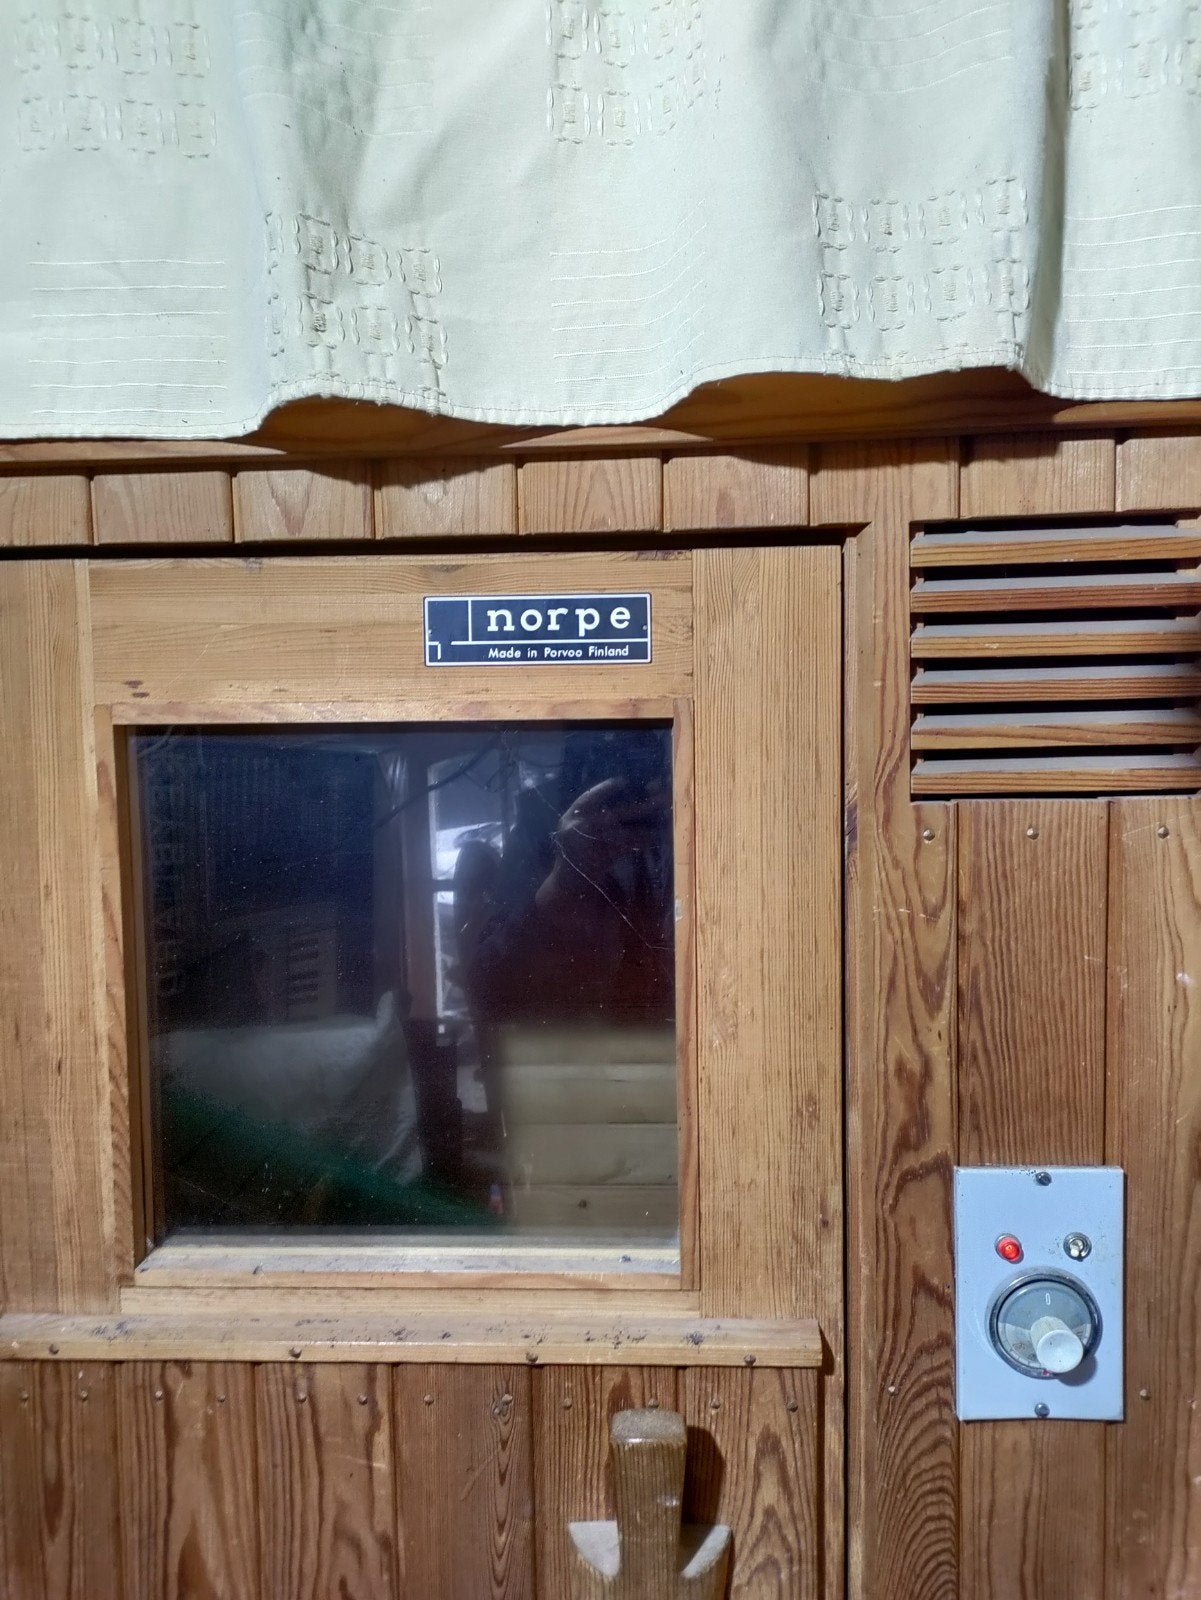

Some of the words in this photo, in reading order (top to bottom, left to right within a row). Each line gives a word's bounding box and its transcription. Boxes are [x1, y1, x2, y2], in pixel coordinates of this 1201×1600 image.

[487, 606, 631, 637] norpe
[488, 647, 521, 659] Made
[527, 648, 538, 658] in
[544, 646, 583, 658] Porvoo
[588, 645, 629, 657] Finland
